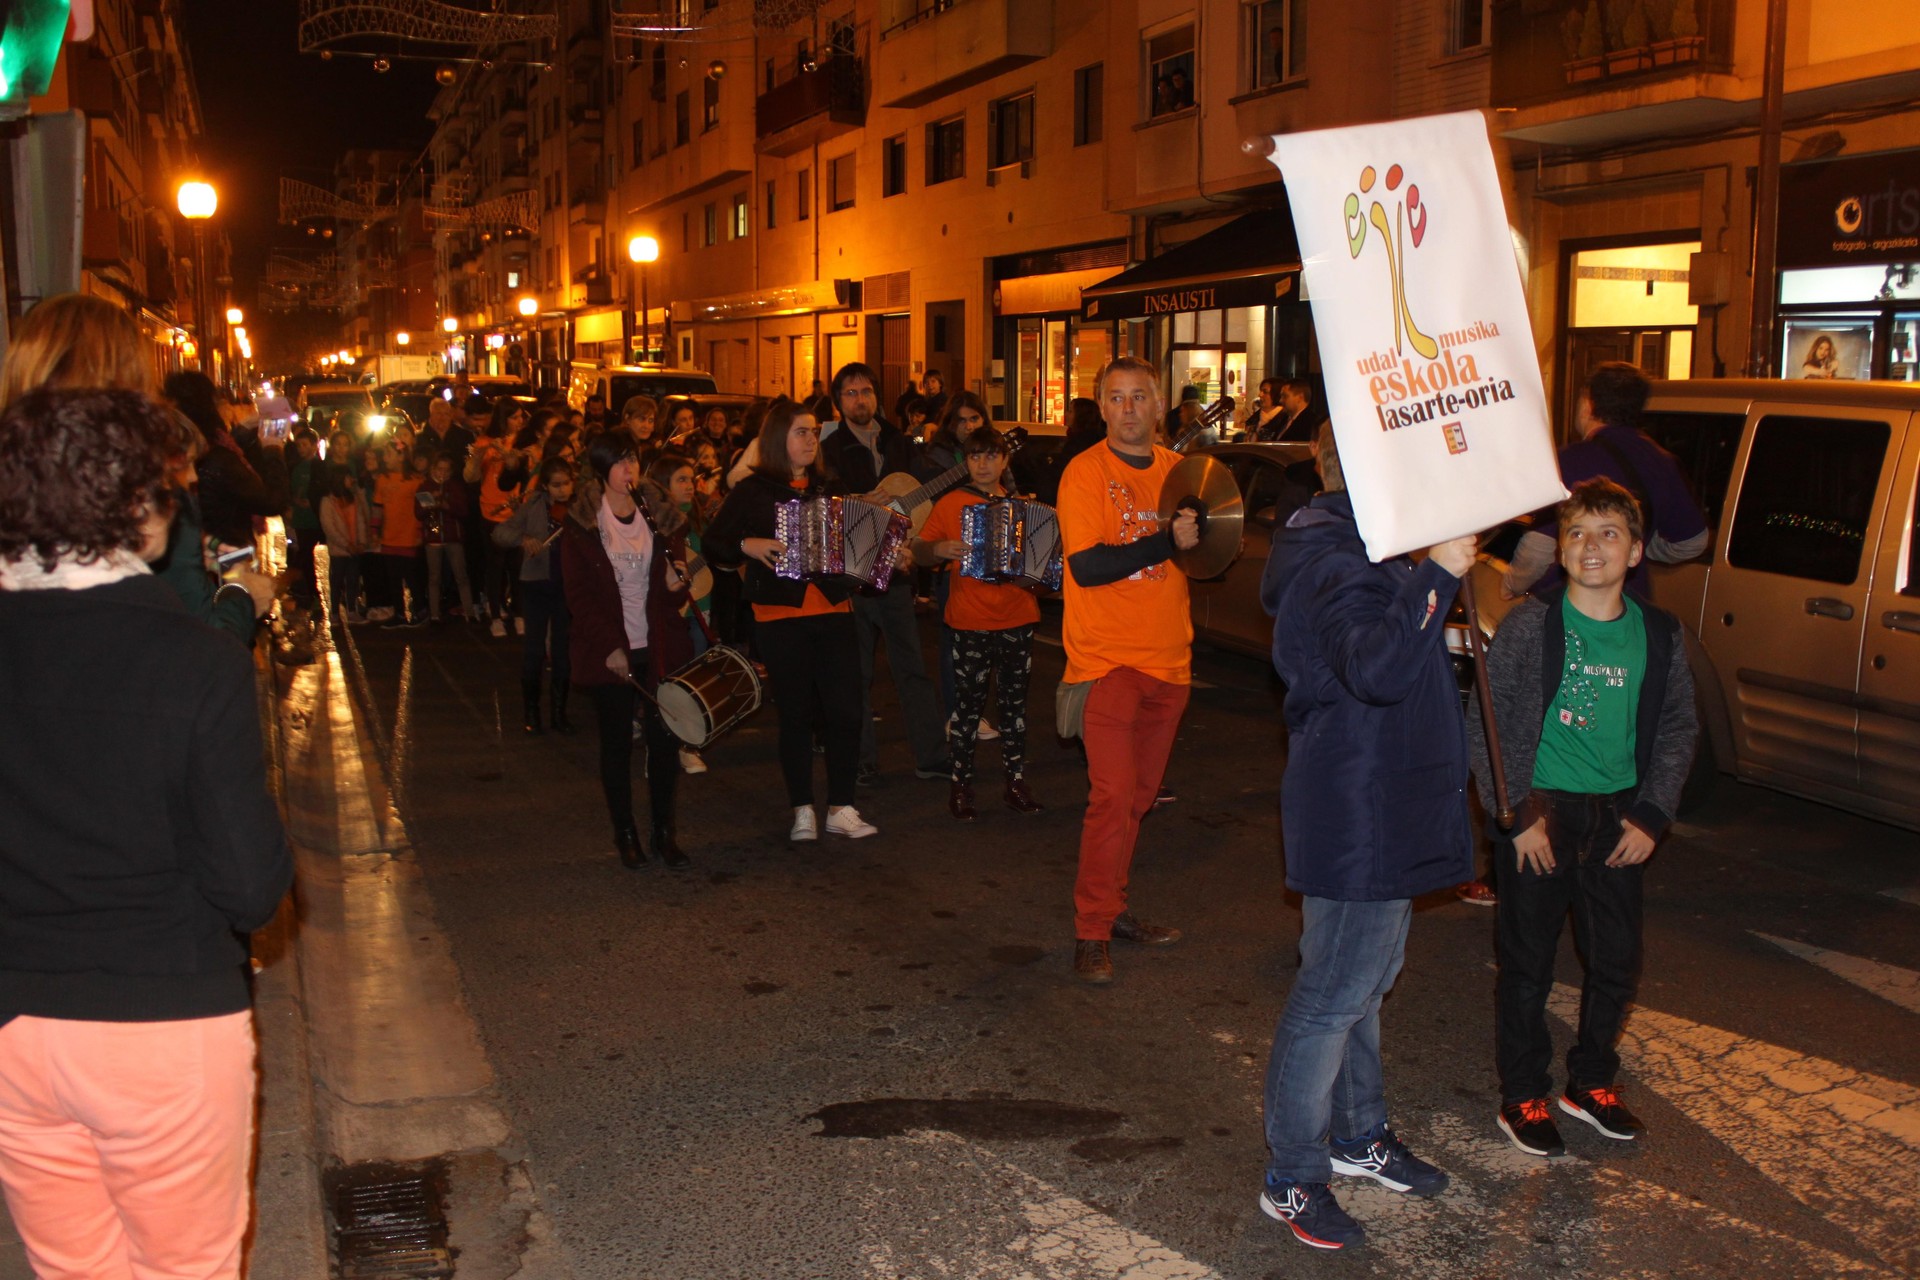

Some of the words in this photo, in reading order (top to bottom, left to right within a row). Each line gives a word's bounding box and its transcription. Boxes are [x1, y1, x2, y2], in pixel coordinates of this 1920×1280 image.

[1144, 288, 1216, 315] INSAUSTI
[1356, 347, 1398, 376] udal
[1438, 320, 1500, 349] musika
[1369, 349, 1481, 405] eskola
[1375, 376, 1515, 432] lasarte-oria
[1605, 677, 1624, 687] 2015
